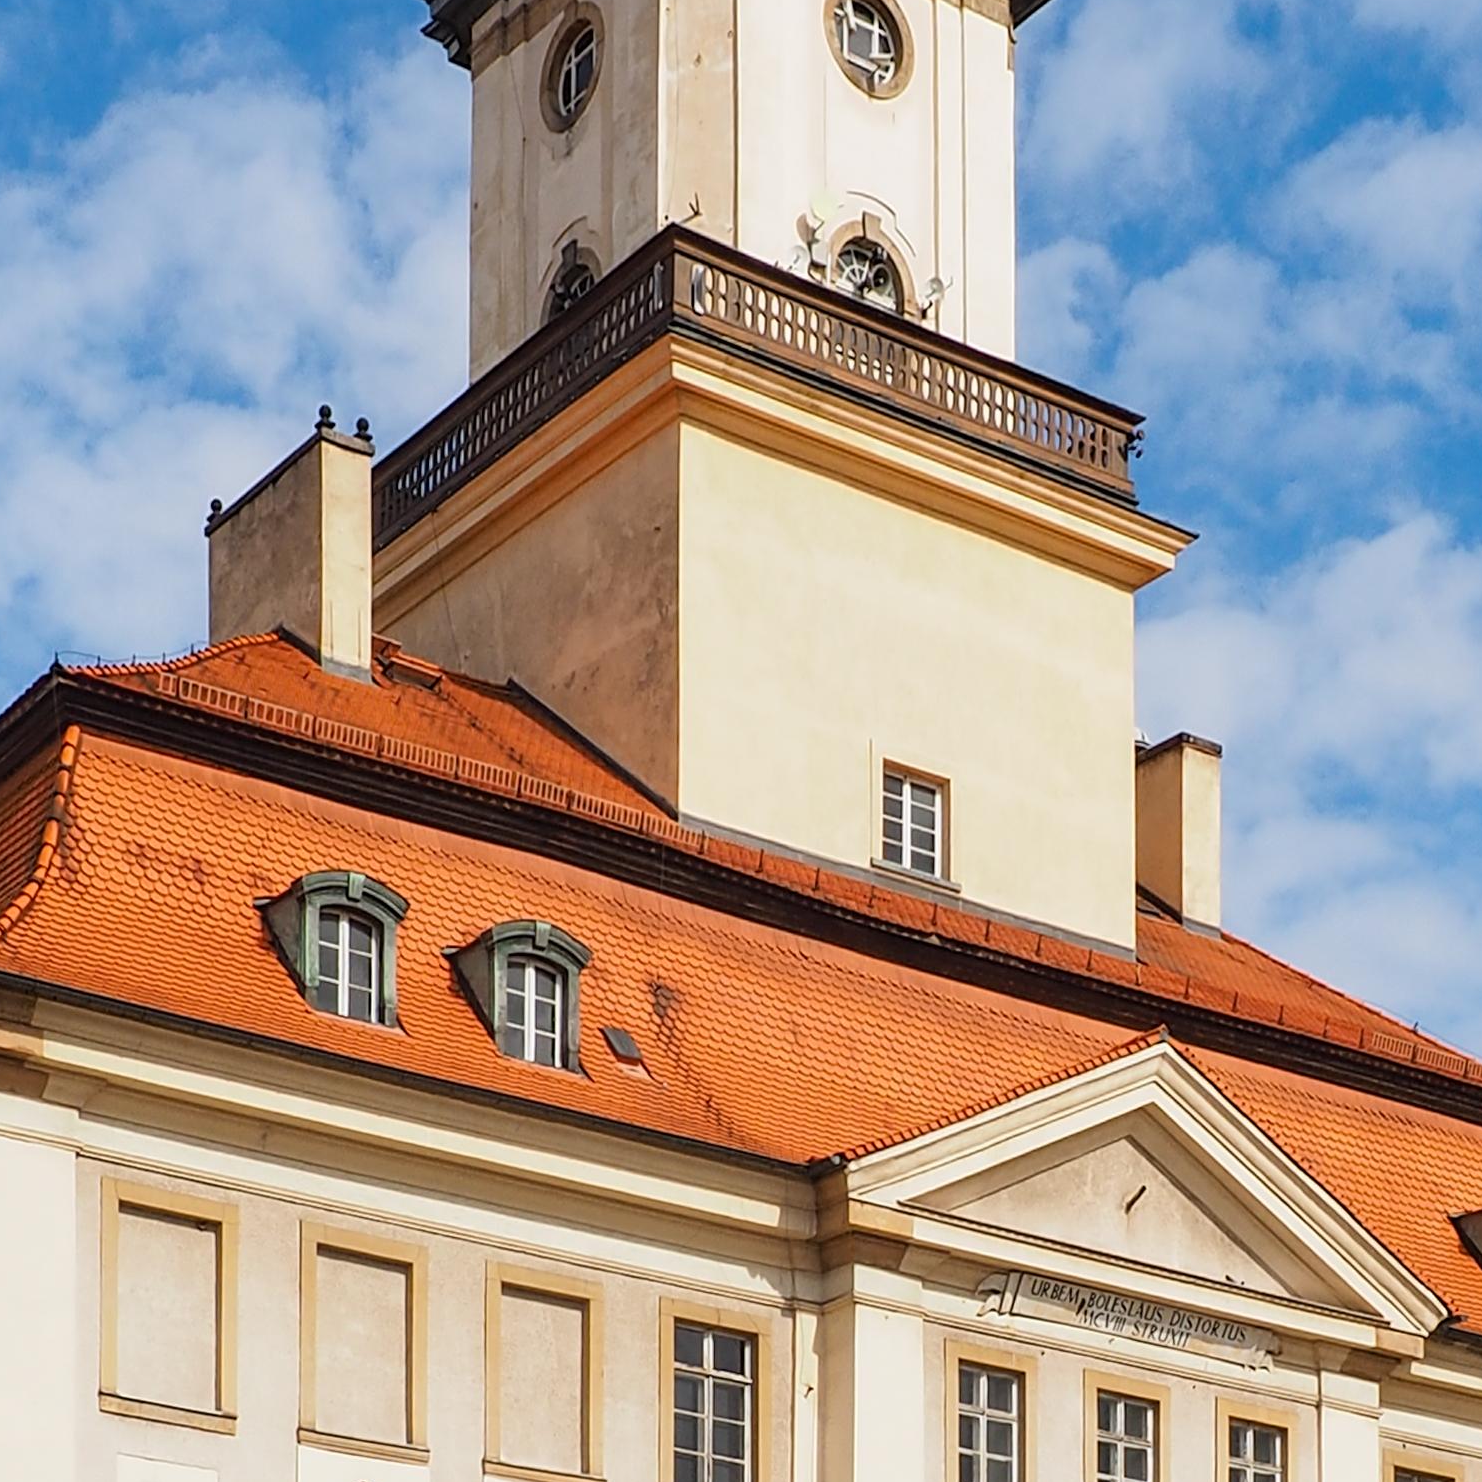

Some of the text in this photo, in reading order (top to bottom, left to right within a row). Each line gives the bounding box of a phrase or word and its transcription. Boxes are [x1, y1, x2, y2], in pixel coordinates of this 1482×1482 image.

[1031, 1279, 1247, 1343] URBEM BOLESLAUS DISTORTUS
[1132, 1320, 1192, 1348] STRUXIT
